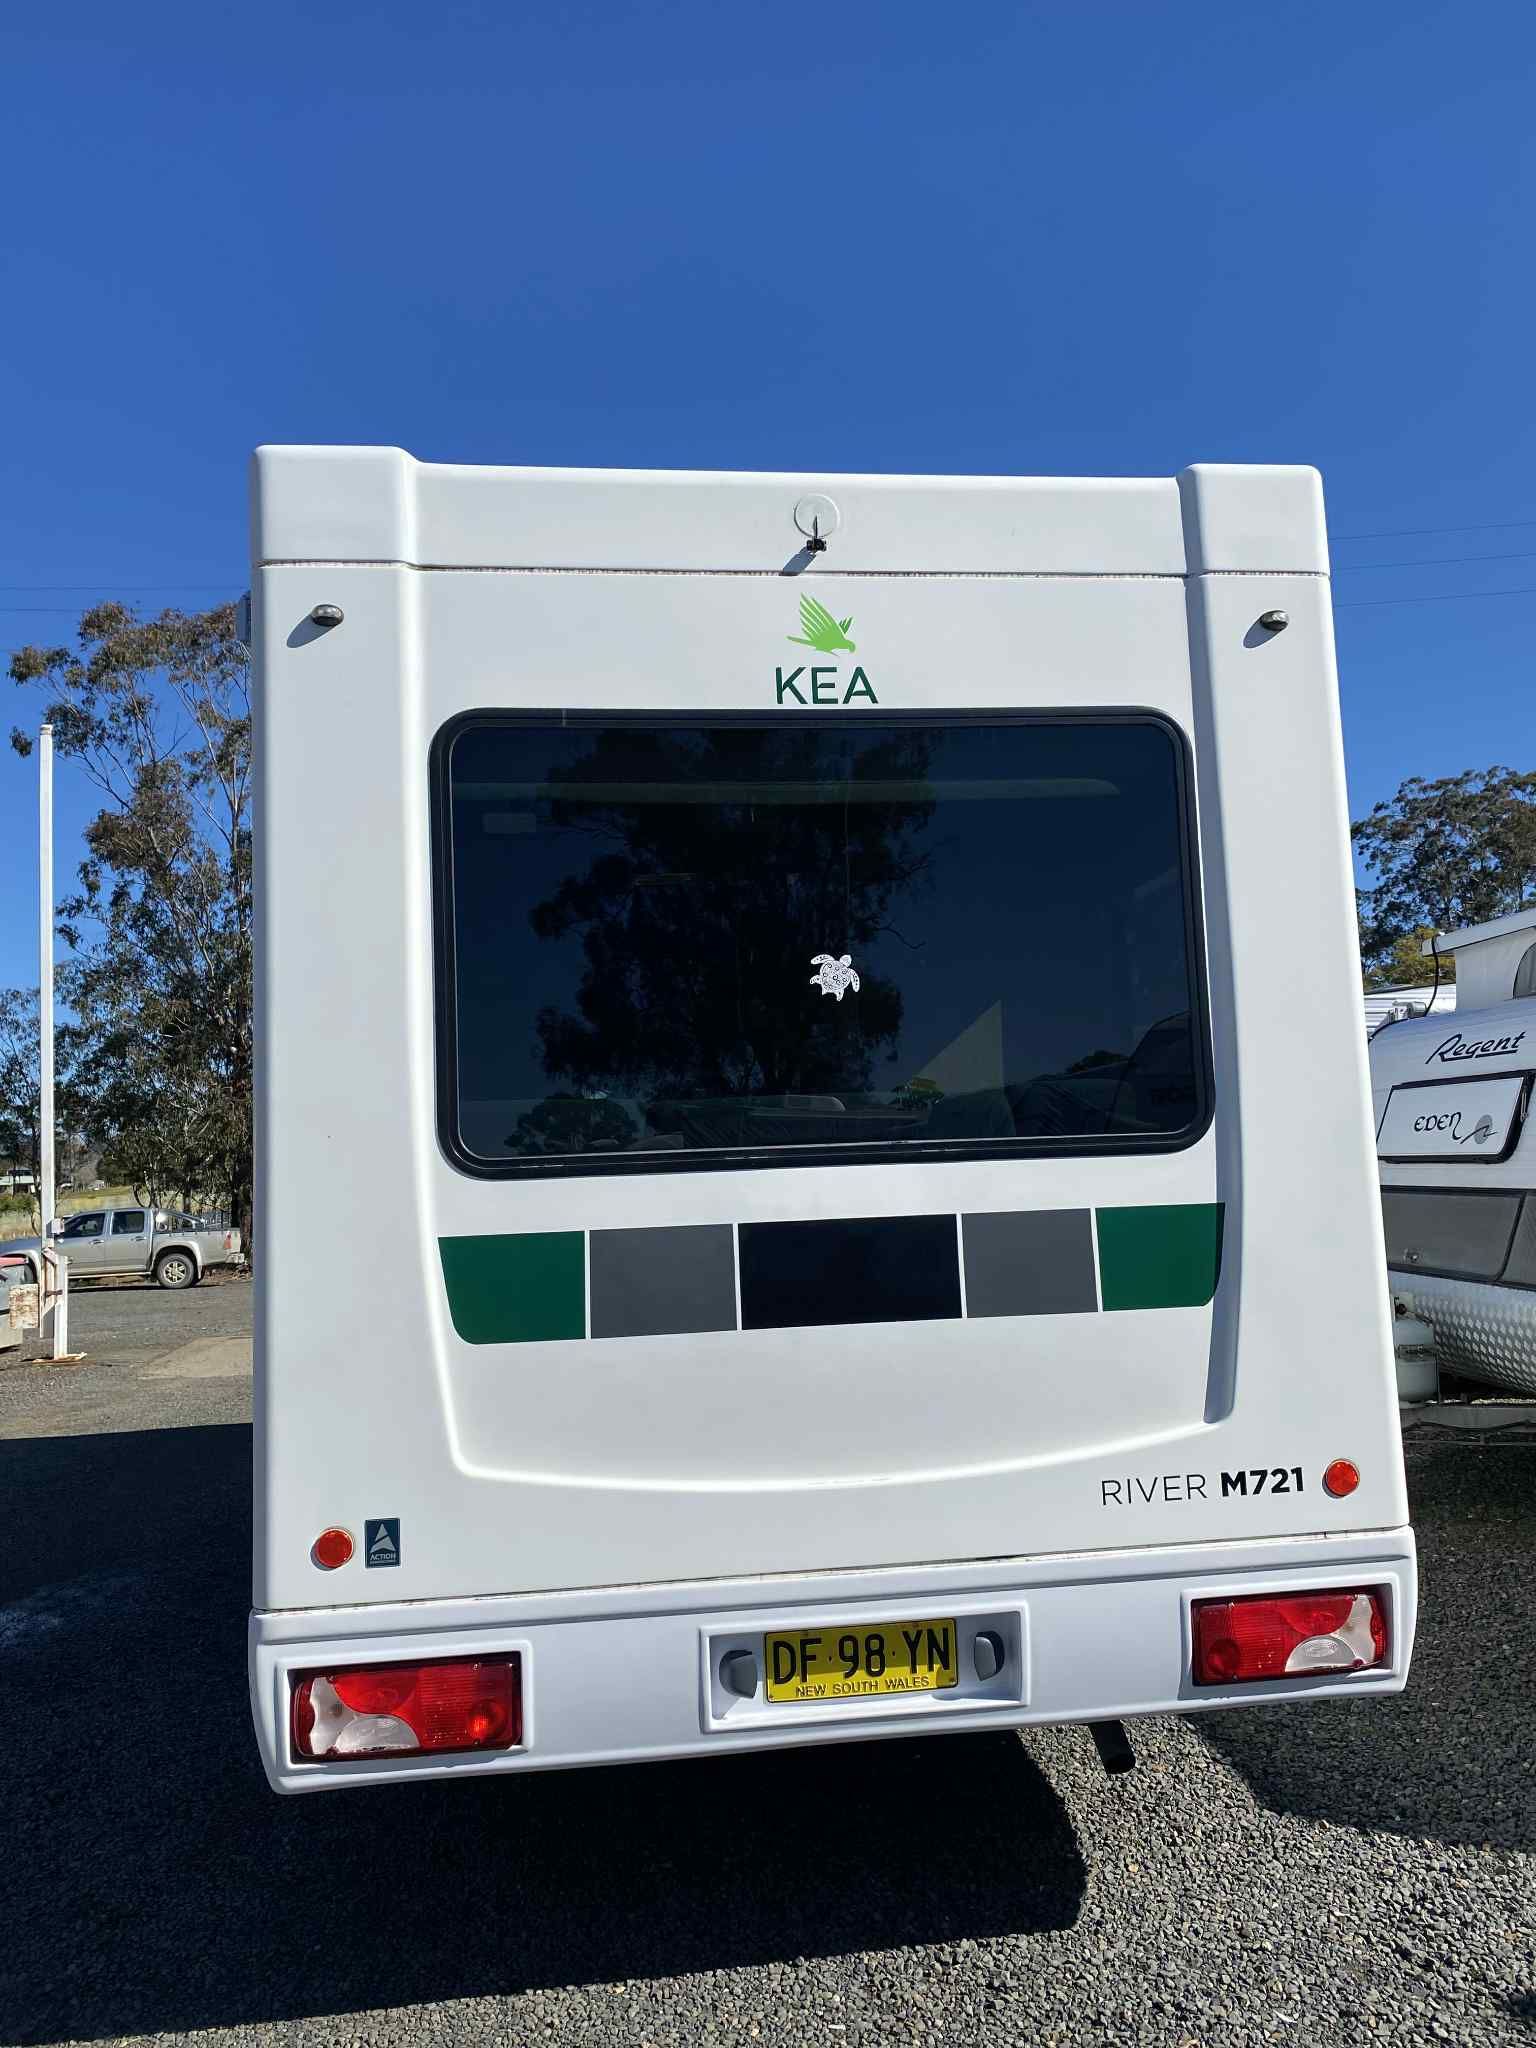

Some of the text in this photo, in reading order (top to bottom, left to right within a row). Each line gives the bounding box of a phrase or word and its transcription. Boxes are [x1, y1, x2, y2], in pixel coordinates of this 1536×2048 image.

[775, 666, 879, 705] KEA
[1425, 1031, 1527, 1065] Regent
[1101, 1466, 1305, 1506] RIVER M721
[370, 1552, 396, 1561] ACTION
[796, 1675, 930, 1698] NEW SOUTH WALES
